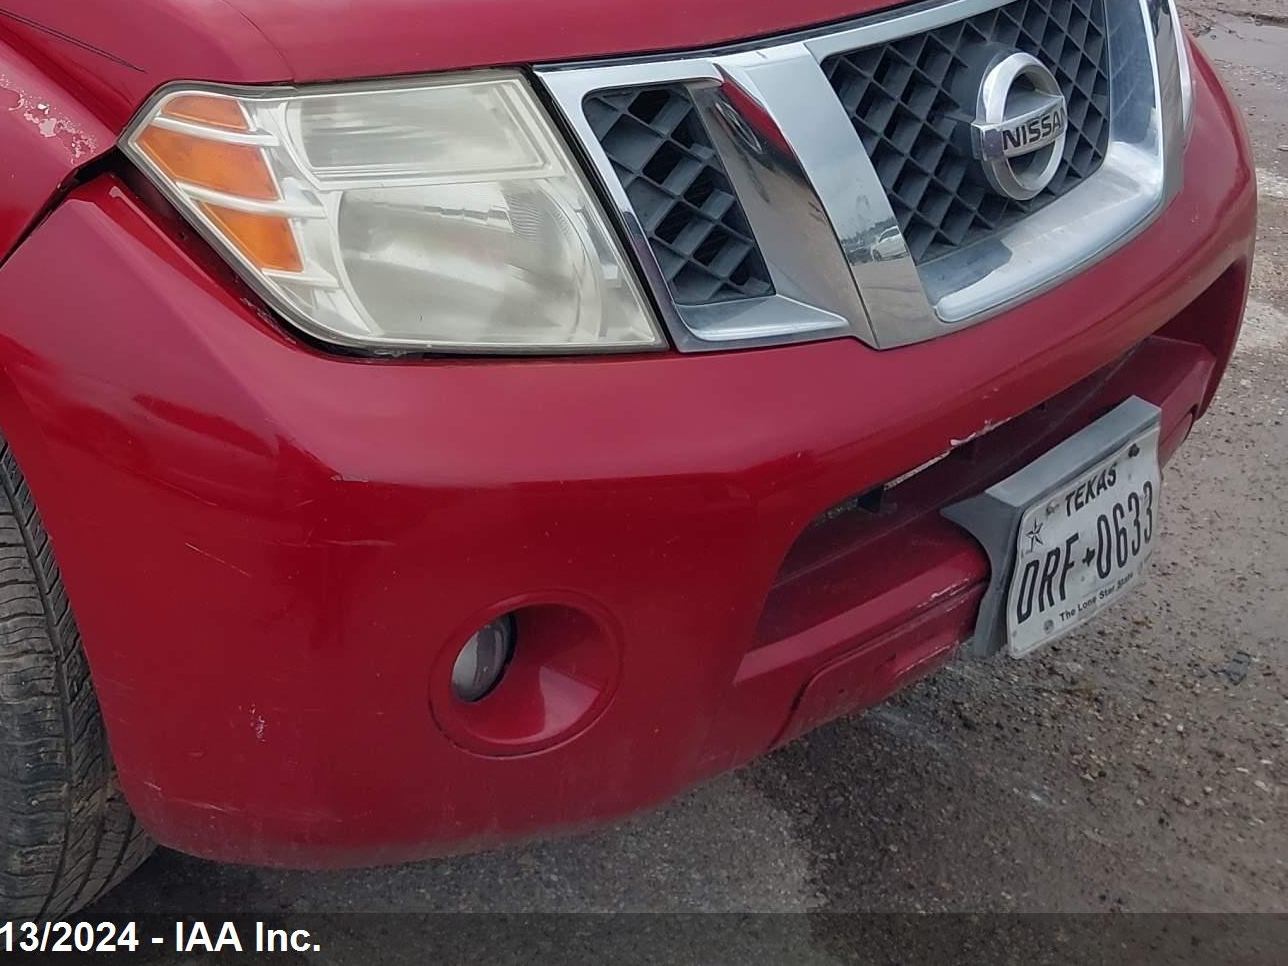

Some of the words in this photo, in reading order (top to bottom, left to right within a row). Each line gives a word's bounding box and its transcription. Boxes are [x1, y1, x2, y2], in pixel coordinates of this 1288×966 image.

[1065, 464, 1117, 517] TEXAS
[1017, 532, 1080, 625] DRF
[1096, 480, 1154, 579] 0633
[1058, 608, 1076, 622] The
[1077, 596, 1097, 612] Lone
[1098, 584, 1115, 600] Star
[1116, 571, 1134, 590] State
